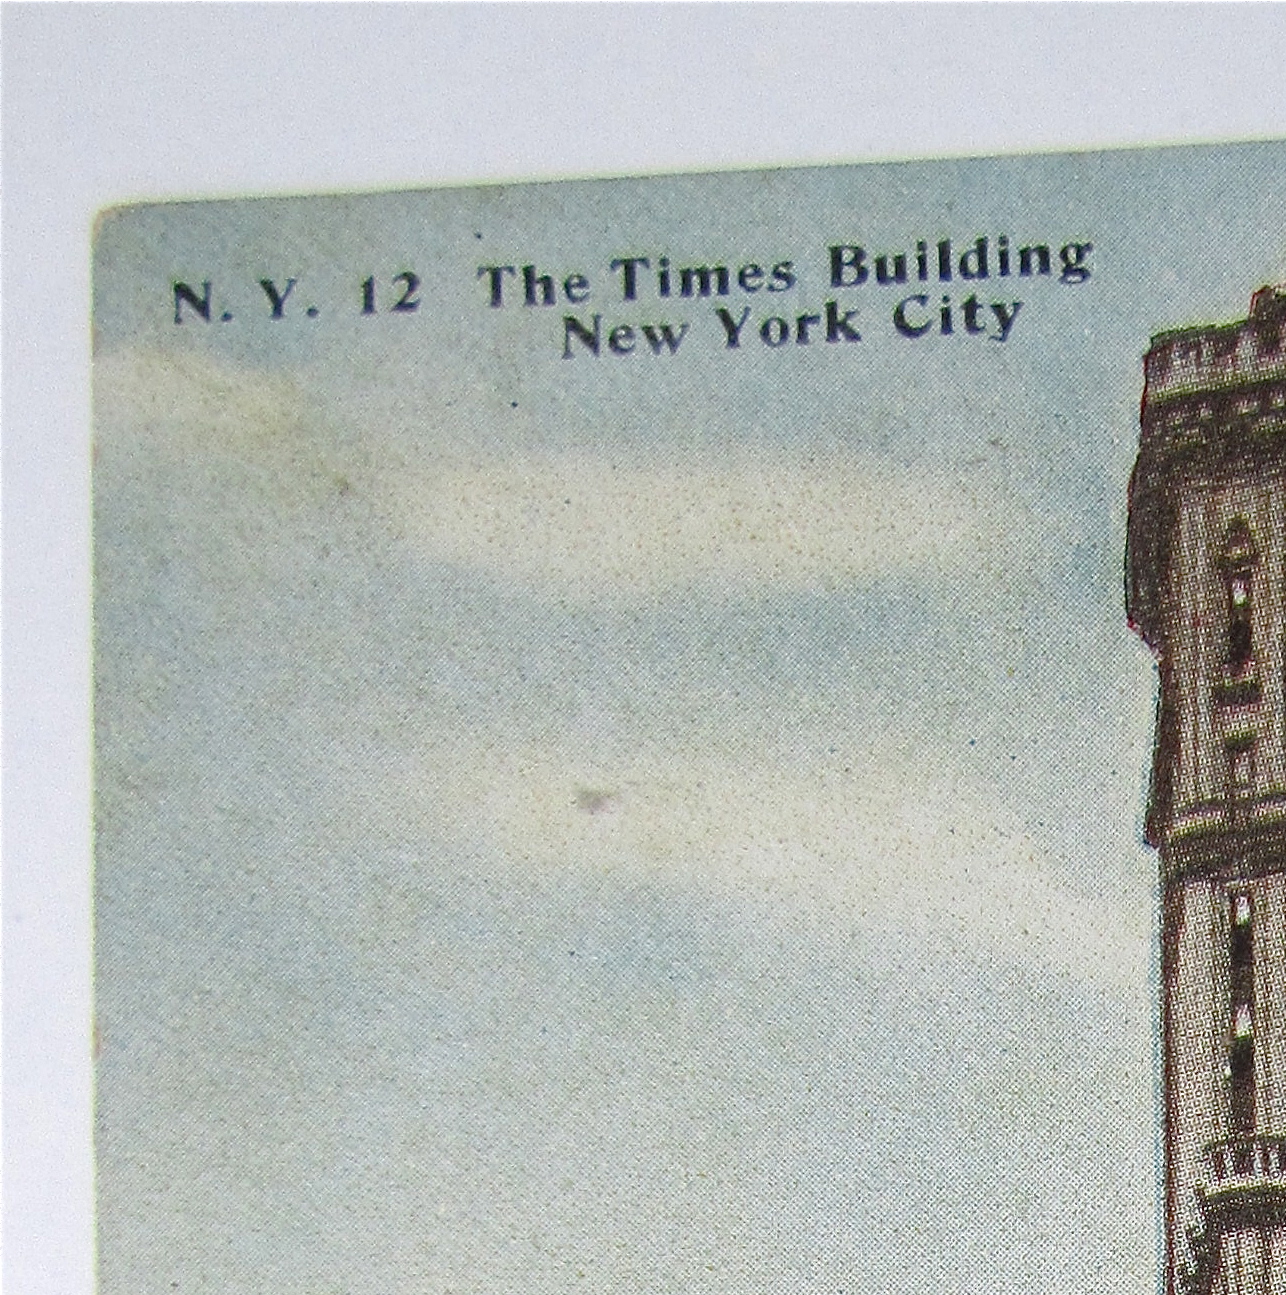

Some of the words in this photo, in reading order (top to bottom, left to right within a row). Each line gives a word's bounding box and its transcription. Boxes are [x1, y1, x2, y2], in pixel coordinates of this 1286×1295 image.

[172, 280, 233, 324] N.
[258, 277, 320, 320] Y.
[360, 271, 421, 315] 12
[477, 264, 590, 307] The
[609, 255, 797, 301] Times
[828, 234, 1094, 288] Building
[562, 314, 690, 359] New
[714, 300, 863, 349] York
[892, 293, 1024, 343] City
